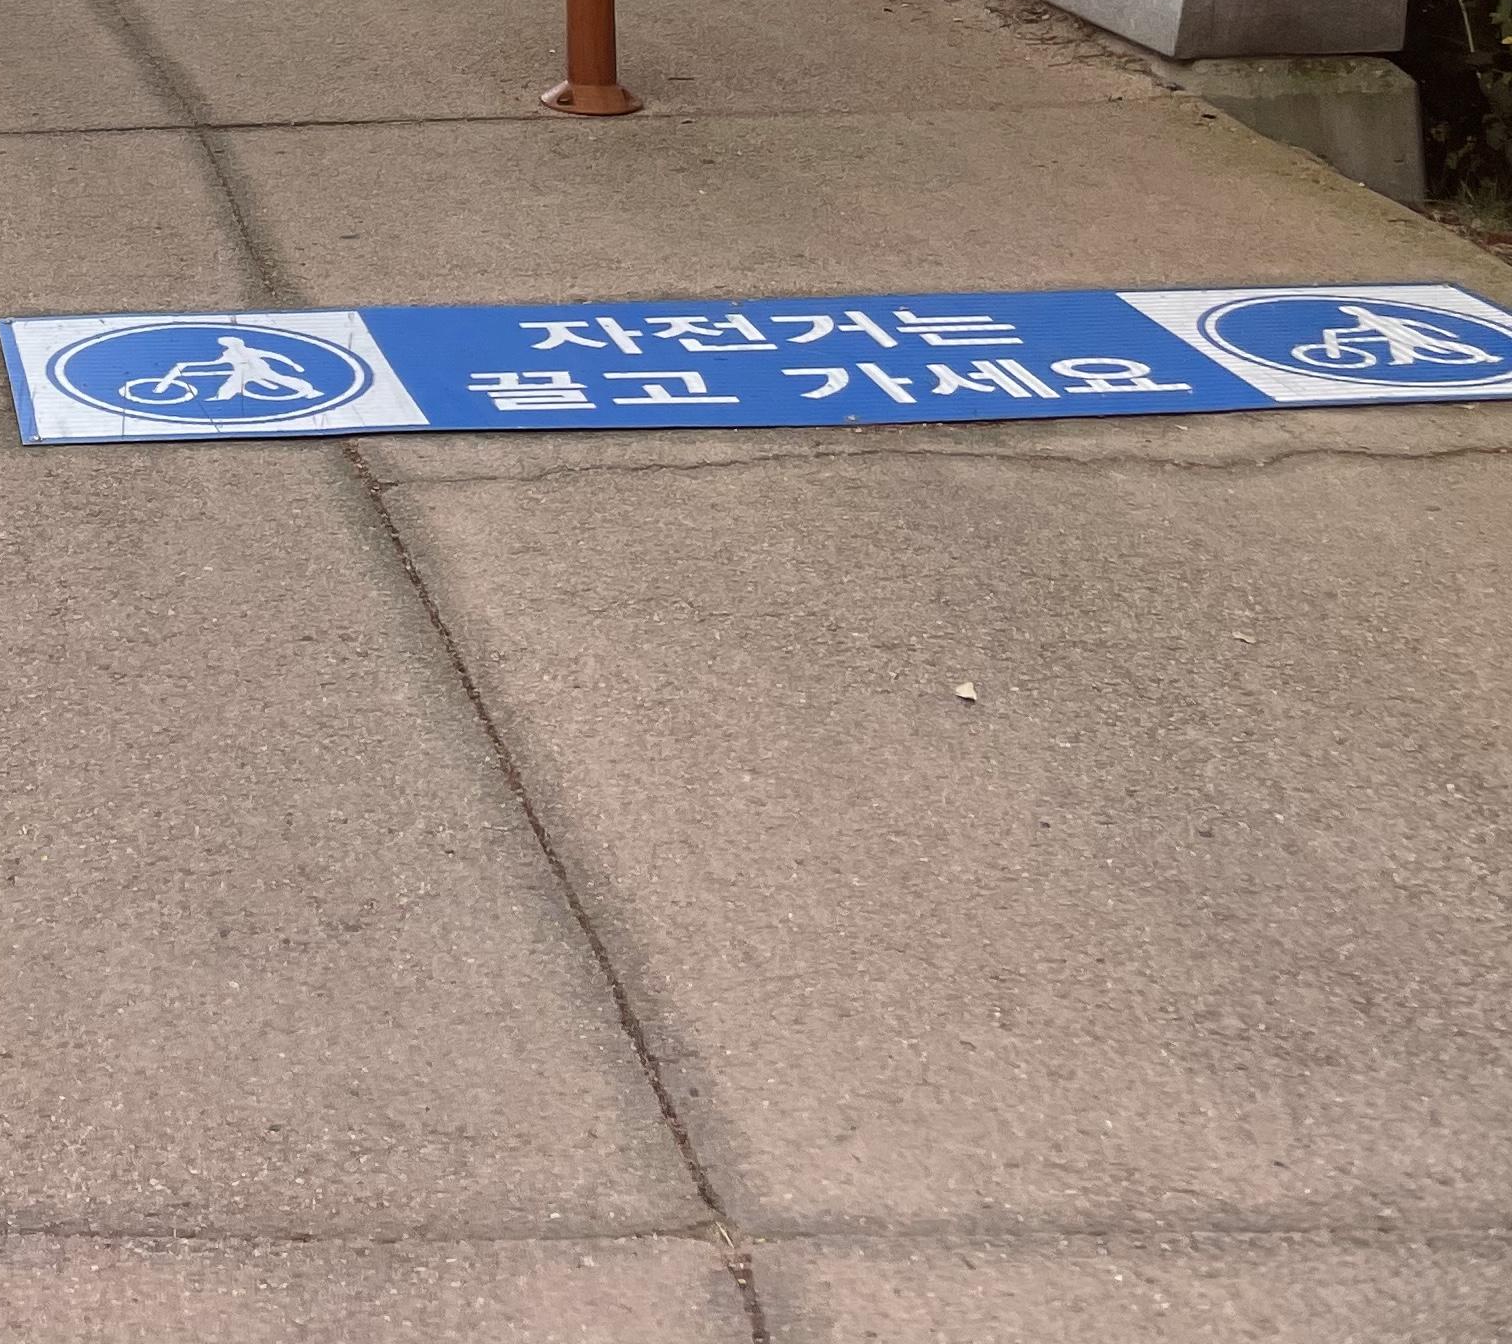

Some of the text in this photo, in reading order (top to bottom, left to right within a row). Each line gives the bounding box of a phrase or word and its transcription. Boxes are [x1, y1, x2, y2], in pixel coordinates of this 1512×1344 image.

[519, 313, 1024, 354] 자전거는
[467, 358, 1192, 411] 끌고 가세요
